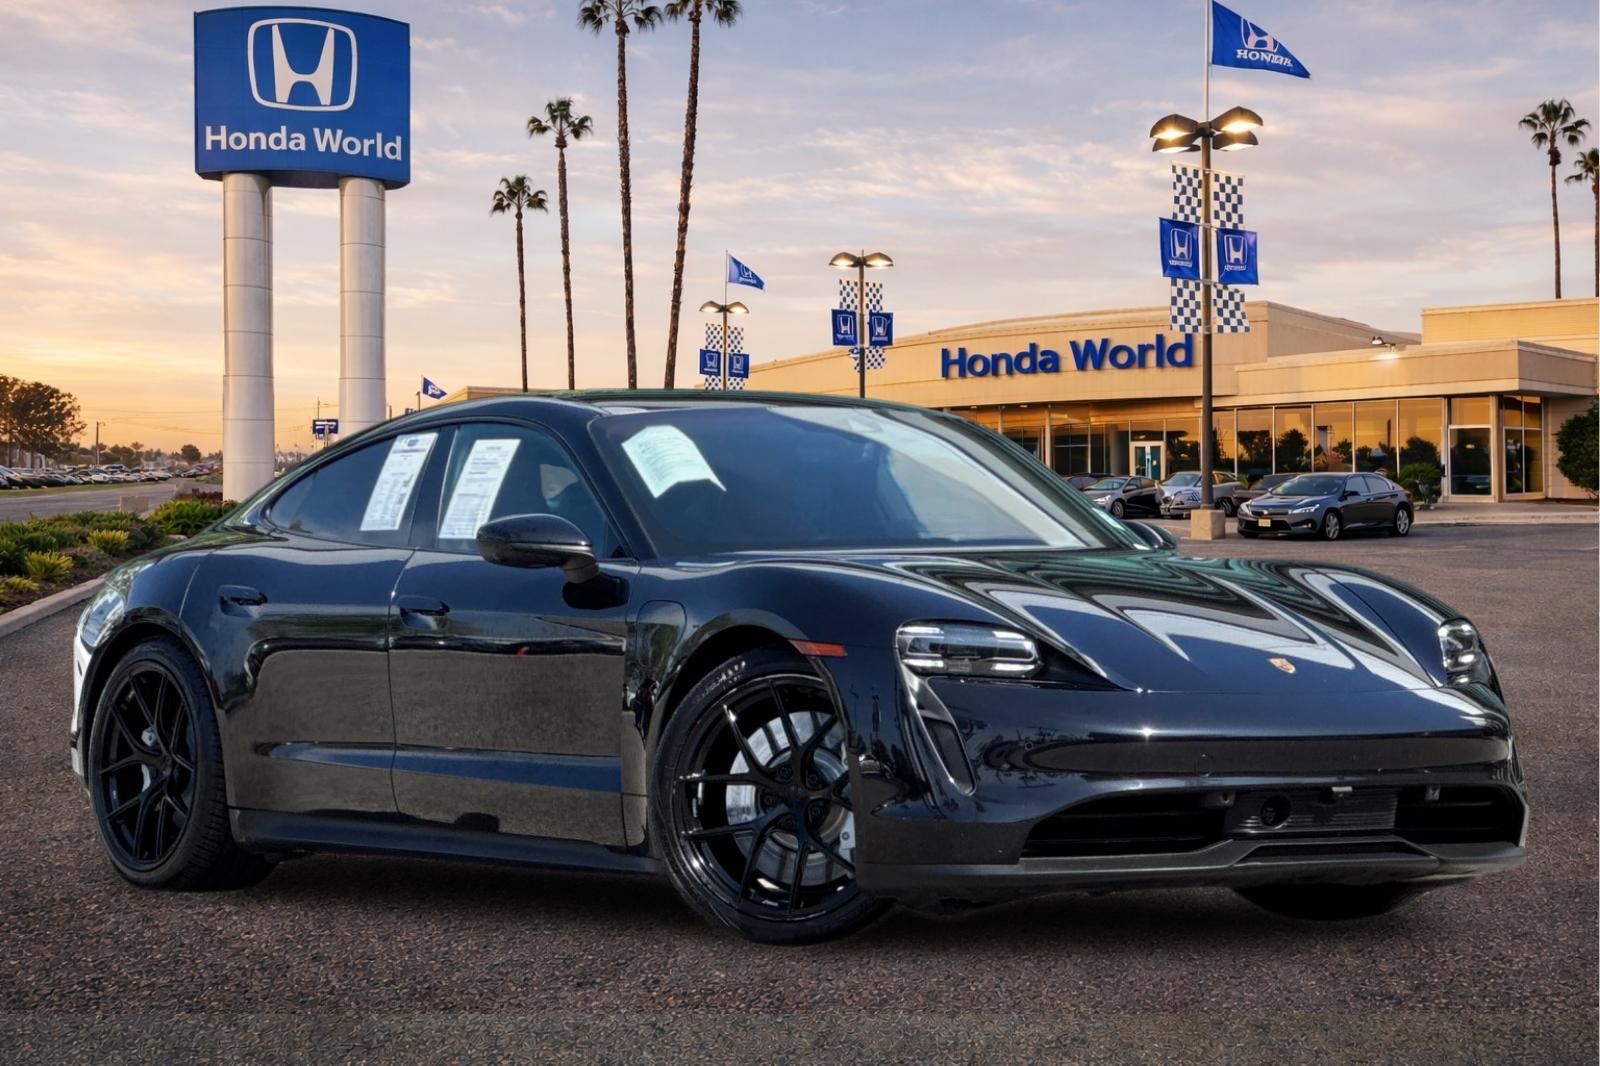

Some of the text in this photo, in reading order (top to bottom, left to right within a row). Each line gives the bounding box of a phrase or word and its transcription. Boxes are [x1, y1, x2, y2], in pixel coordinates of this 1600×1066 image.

[205, 125, 402, 160] Honda World
[941, 333, 1195, 379] Honda World
